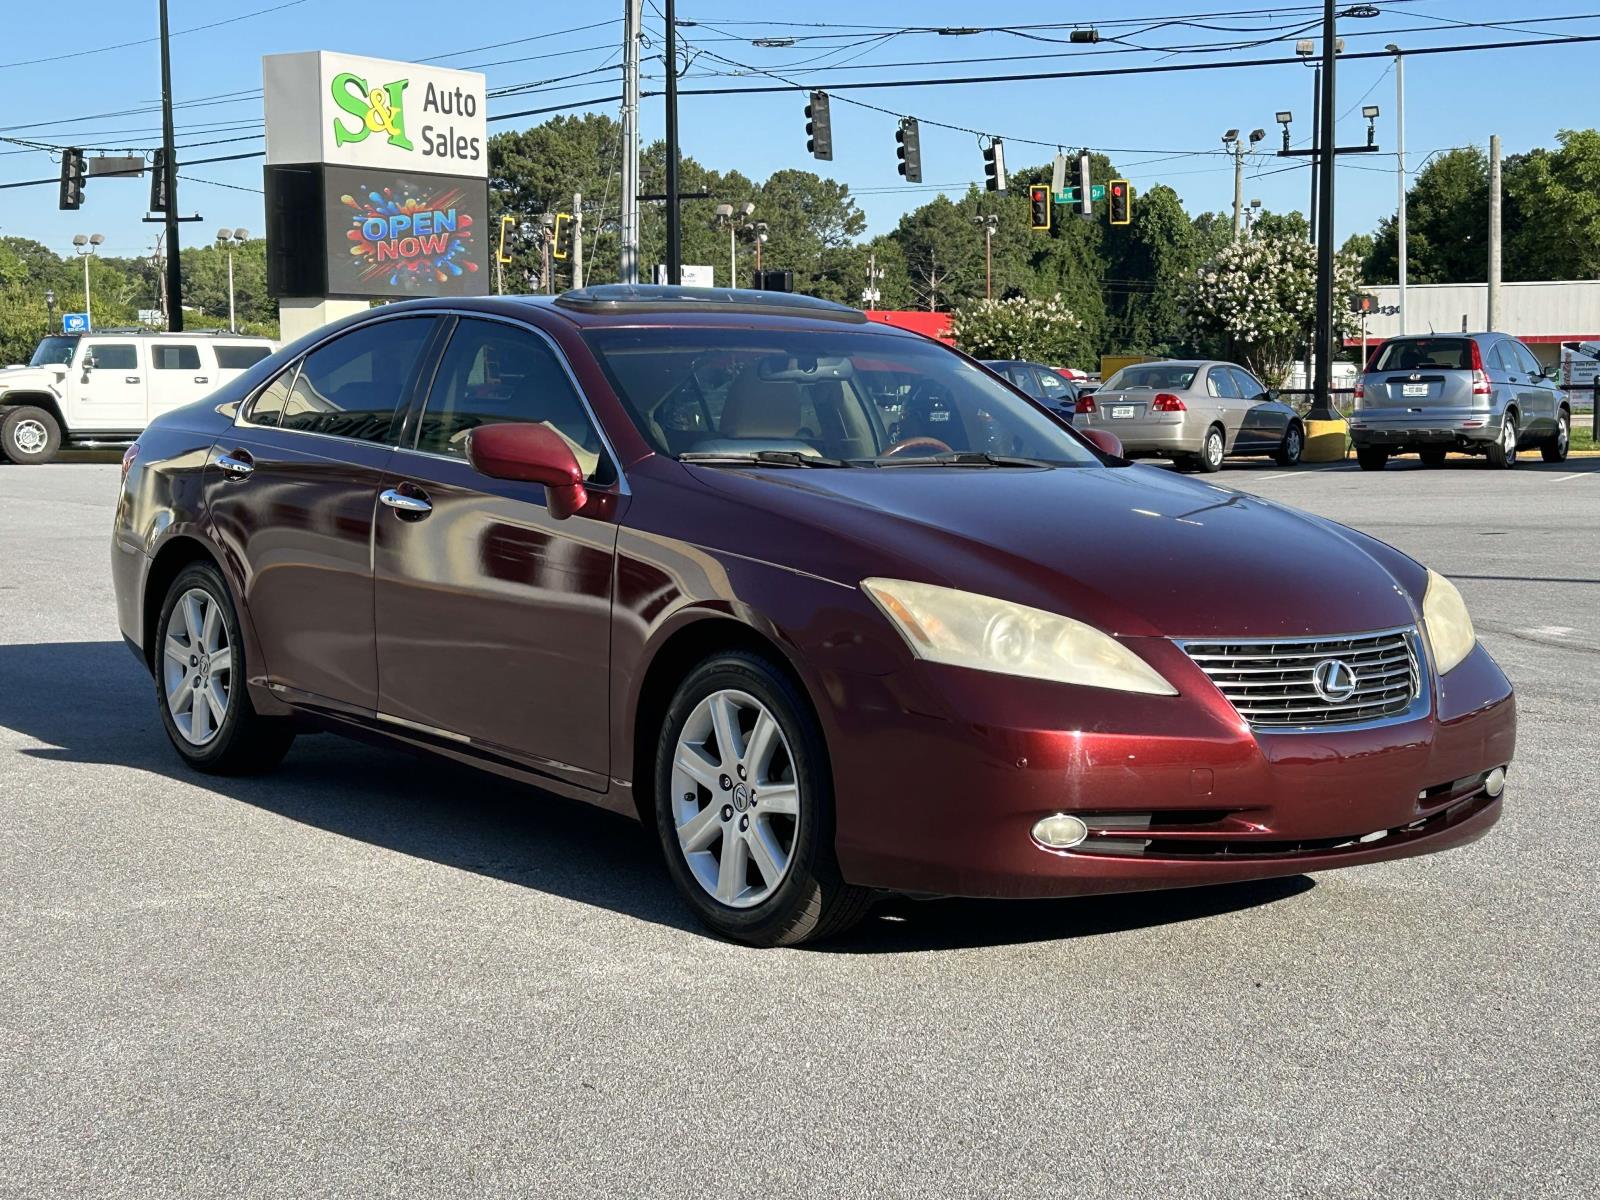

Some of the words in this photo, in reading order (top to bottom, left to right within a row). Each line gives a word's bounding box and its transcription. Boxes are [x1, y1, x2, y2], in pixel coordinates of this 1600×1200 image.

[423, 82, 476, 117] Auto
[421, 125, 480, 161] Sales
[1092, 189, 1101, 198] Dr
[362, 208, 457, 241] OPEN
[377, 233, 449, 262] NOW
